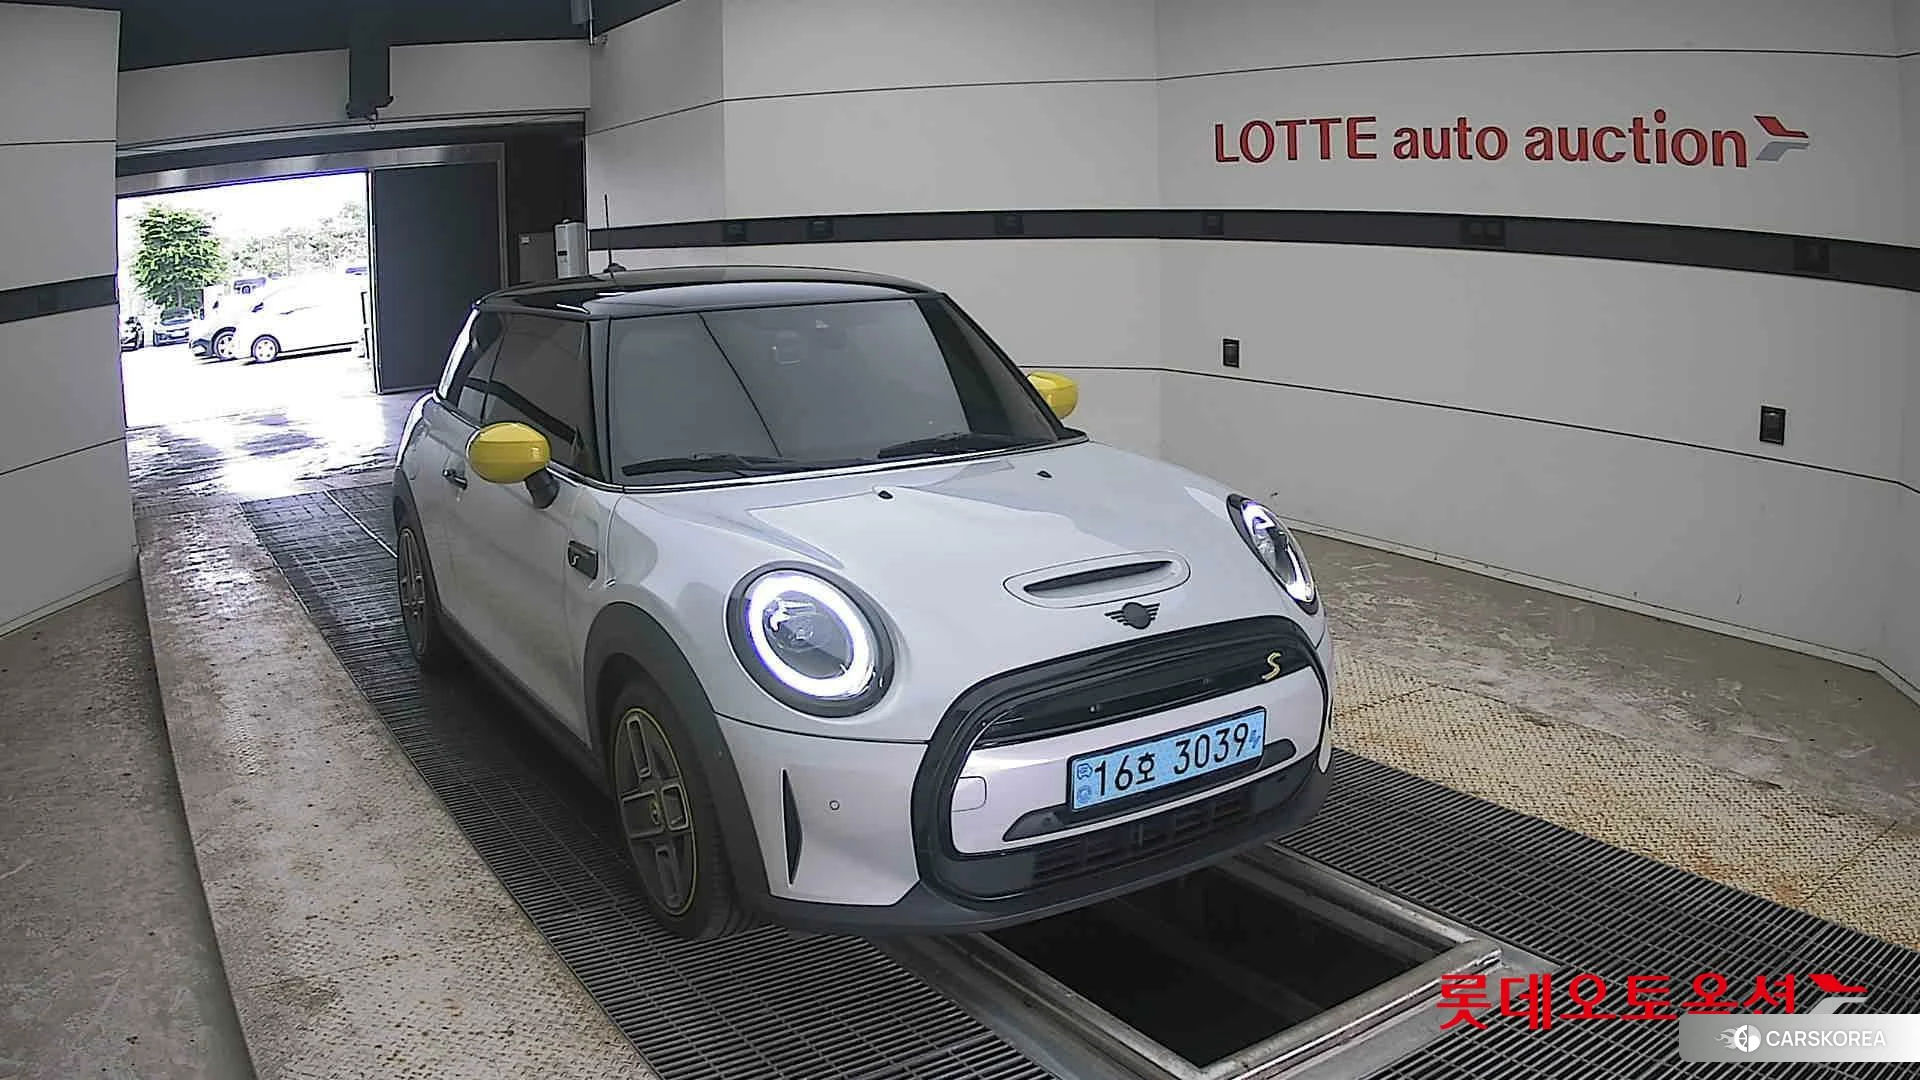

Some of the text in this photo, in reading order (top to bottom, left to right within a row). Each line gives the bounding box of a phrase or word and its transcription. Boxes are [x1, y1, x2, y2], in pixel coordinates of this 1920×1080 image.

[1214, 109, 1748, 168] LOTTE auto auction
[1262, 652, 1281, 680] S
[1094, 752, 1155, 796] 16호
[1173, 722, 1249, 775] 3039
